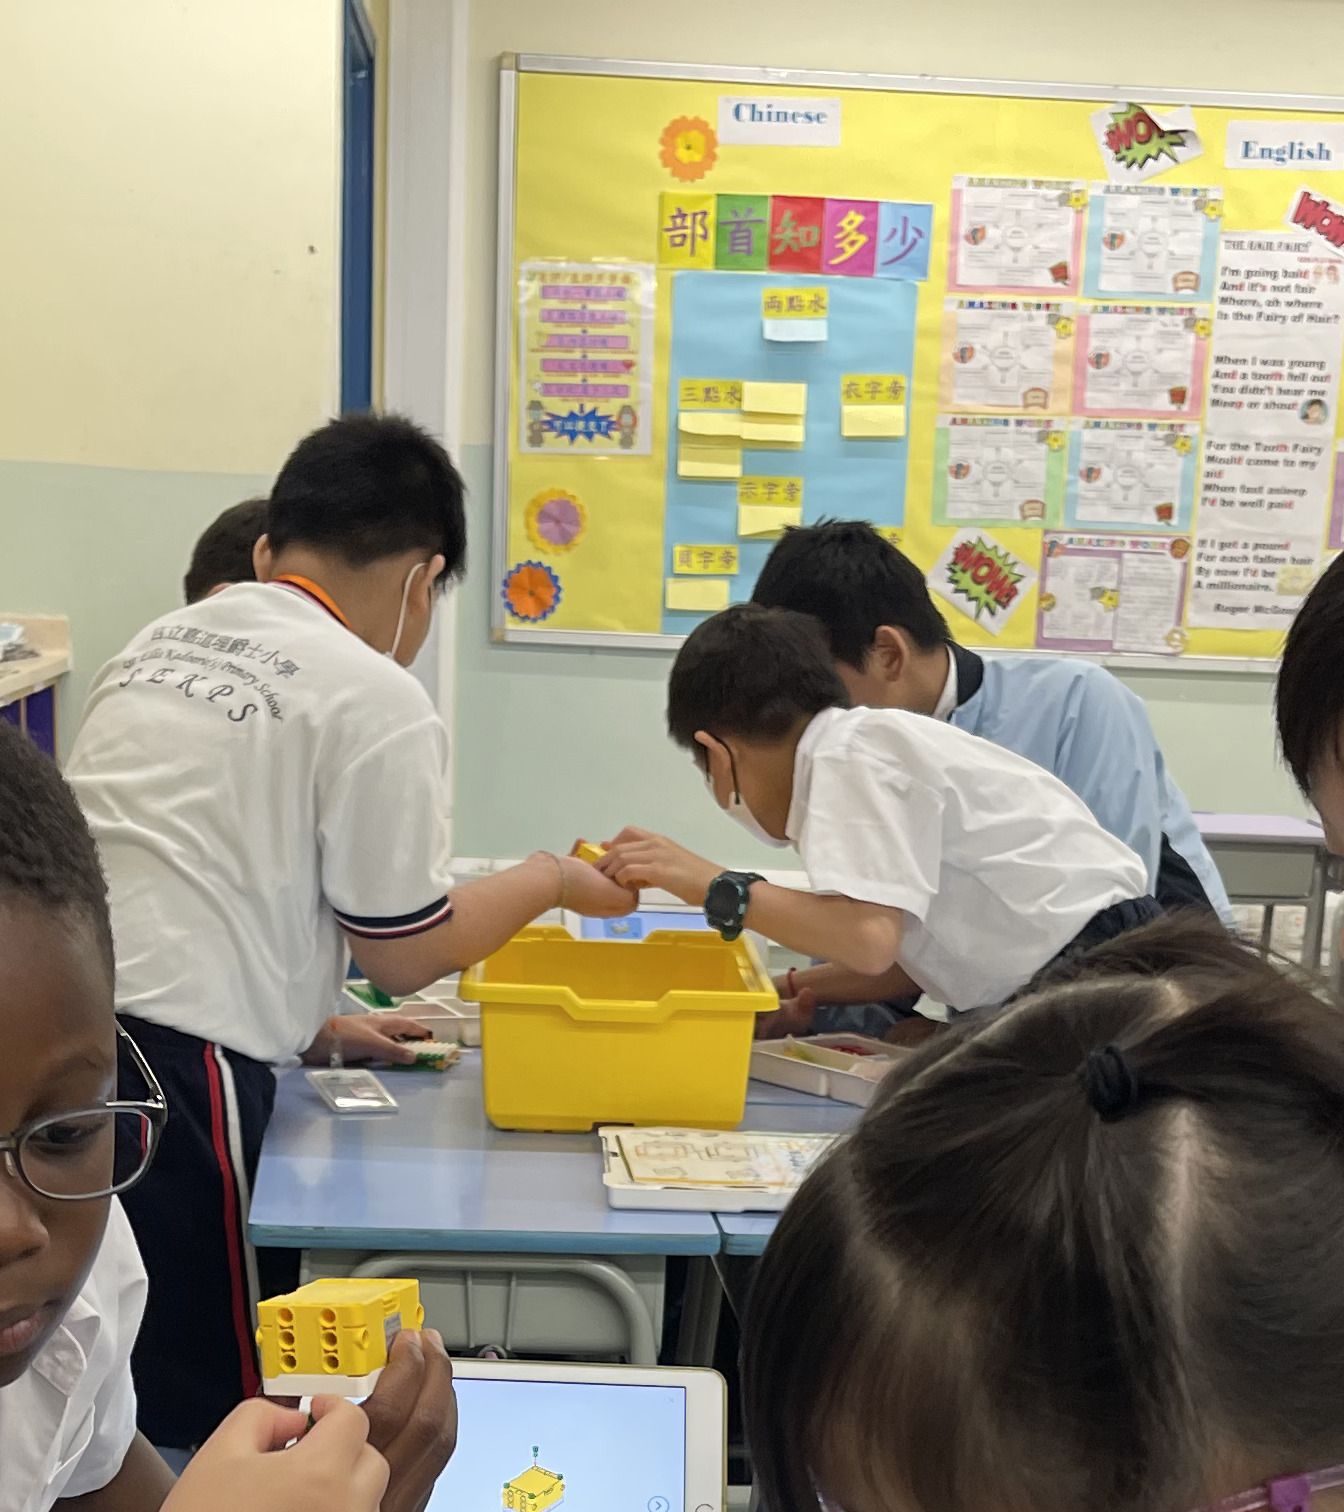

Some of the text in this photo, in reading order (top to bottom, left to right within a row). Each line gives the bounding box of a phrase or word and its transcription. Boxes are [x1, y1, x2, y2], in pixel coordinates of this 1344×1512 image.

[732, 102, 828, 125] Chinese
[1241, 140, 1332, 165] English
[663, 207, 925, 266] 部首知多少
[1244, 268, 1279, 280] going
[1232, 311, 1254, 322] the
[1256, 311, 1288, 325] Fairy
[1287, 358, 1326, 370] young
[1292, 442, 1324, 456] Fairy
[255, 683, 283, 720] School
